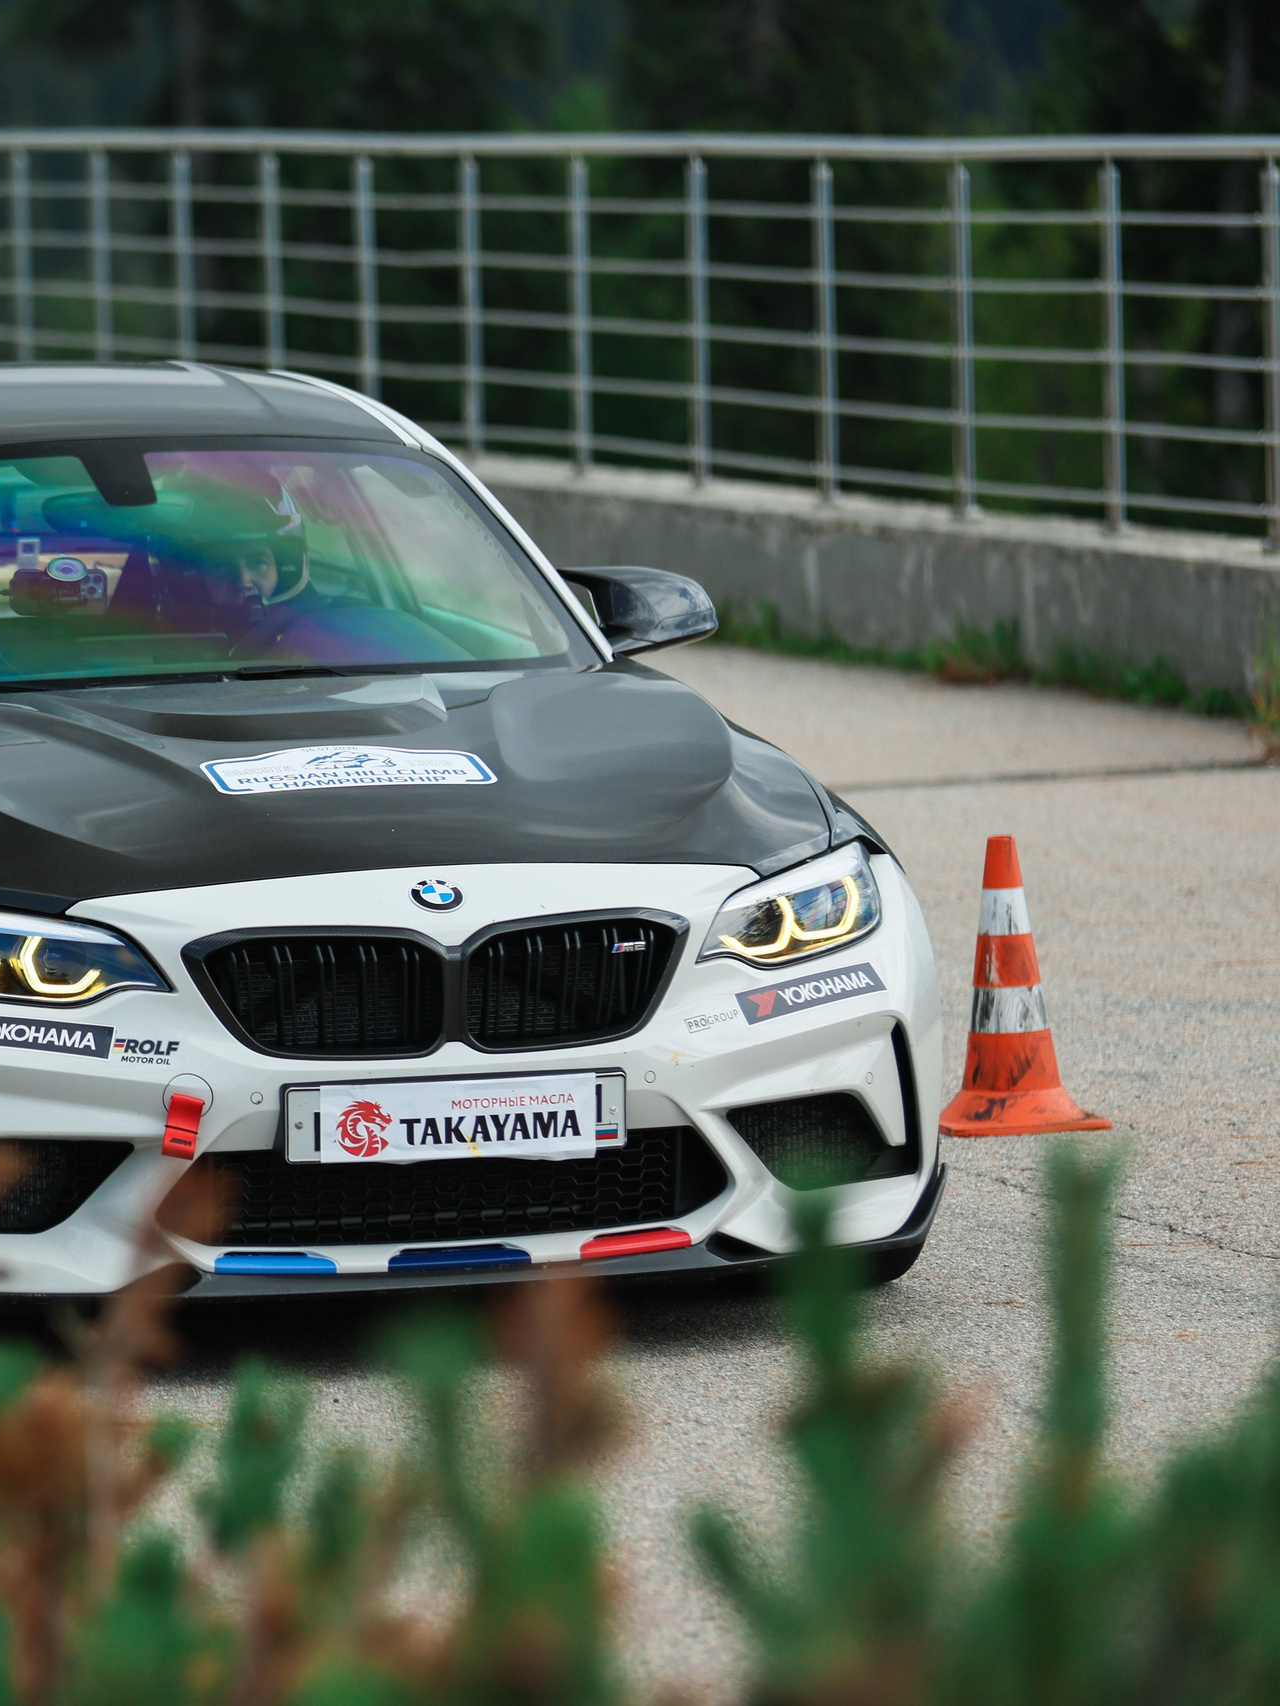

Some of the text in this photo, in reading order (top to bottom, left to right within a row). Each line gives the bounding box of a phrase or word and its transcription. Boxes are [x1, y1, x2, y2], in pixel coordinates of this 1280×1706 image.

[237, 768, 467, 785] RUSSIAN HILLCLIMB
[268, 776, 447, 790] CHAMPIONSHIP
[412, 879, 456, 890] BMW
[777, 970, 875, 1006] YOKOHAMA
[122, 1039, 180, 1056] ROLF
[120, 1055, 171, 1066] MOTOR OIL
[451, 1093, 575, 1110] МОТОРНЫЕ МАСЛА
[399, 1109, 582, 1146] TAKAYAMA
